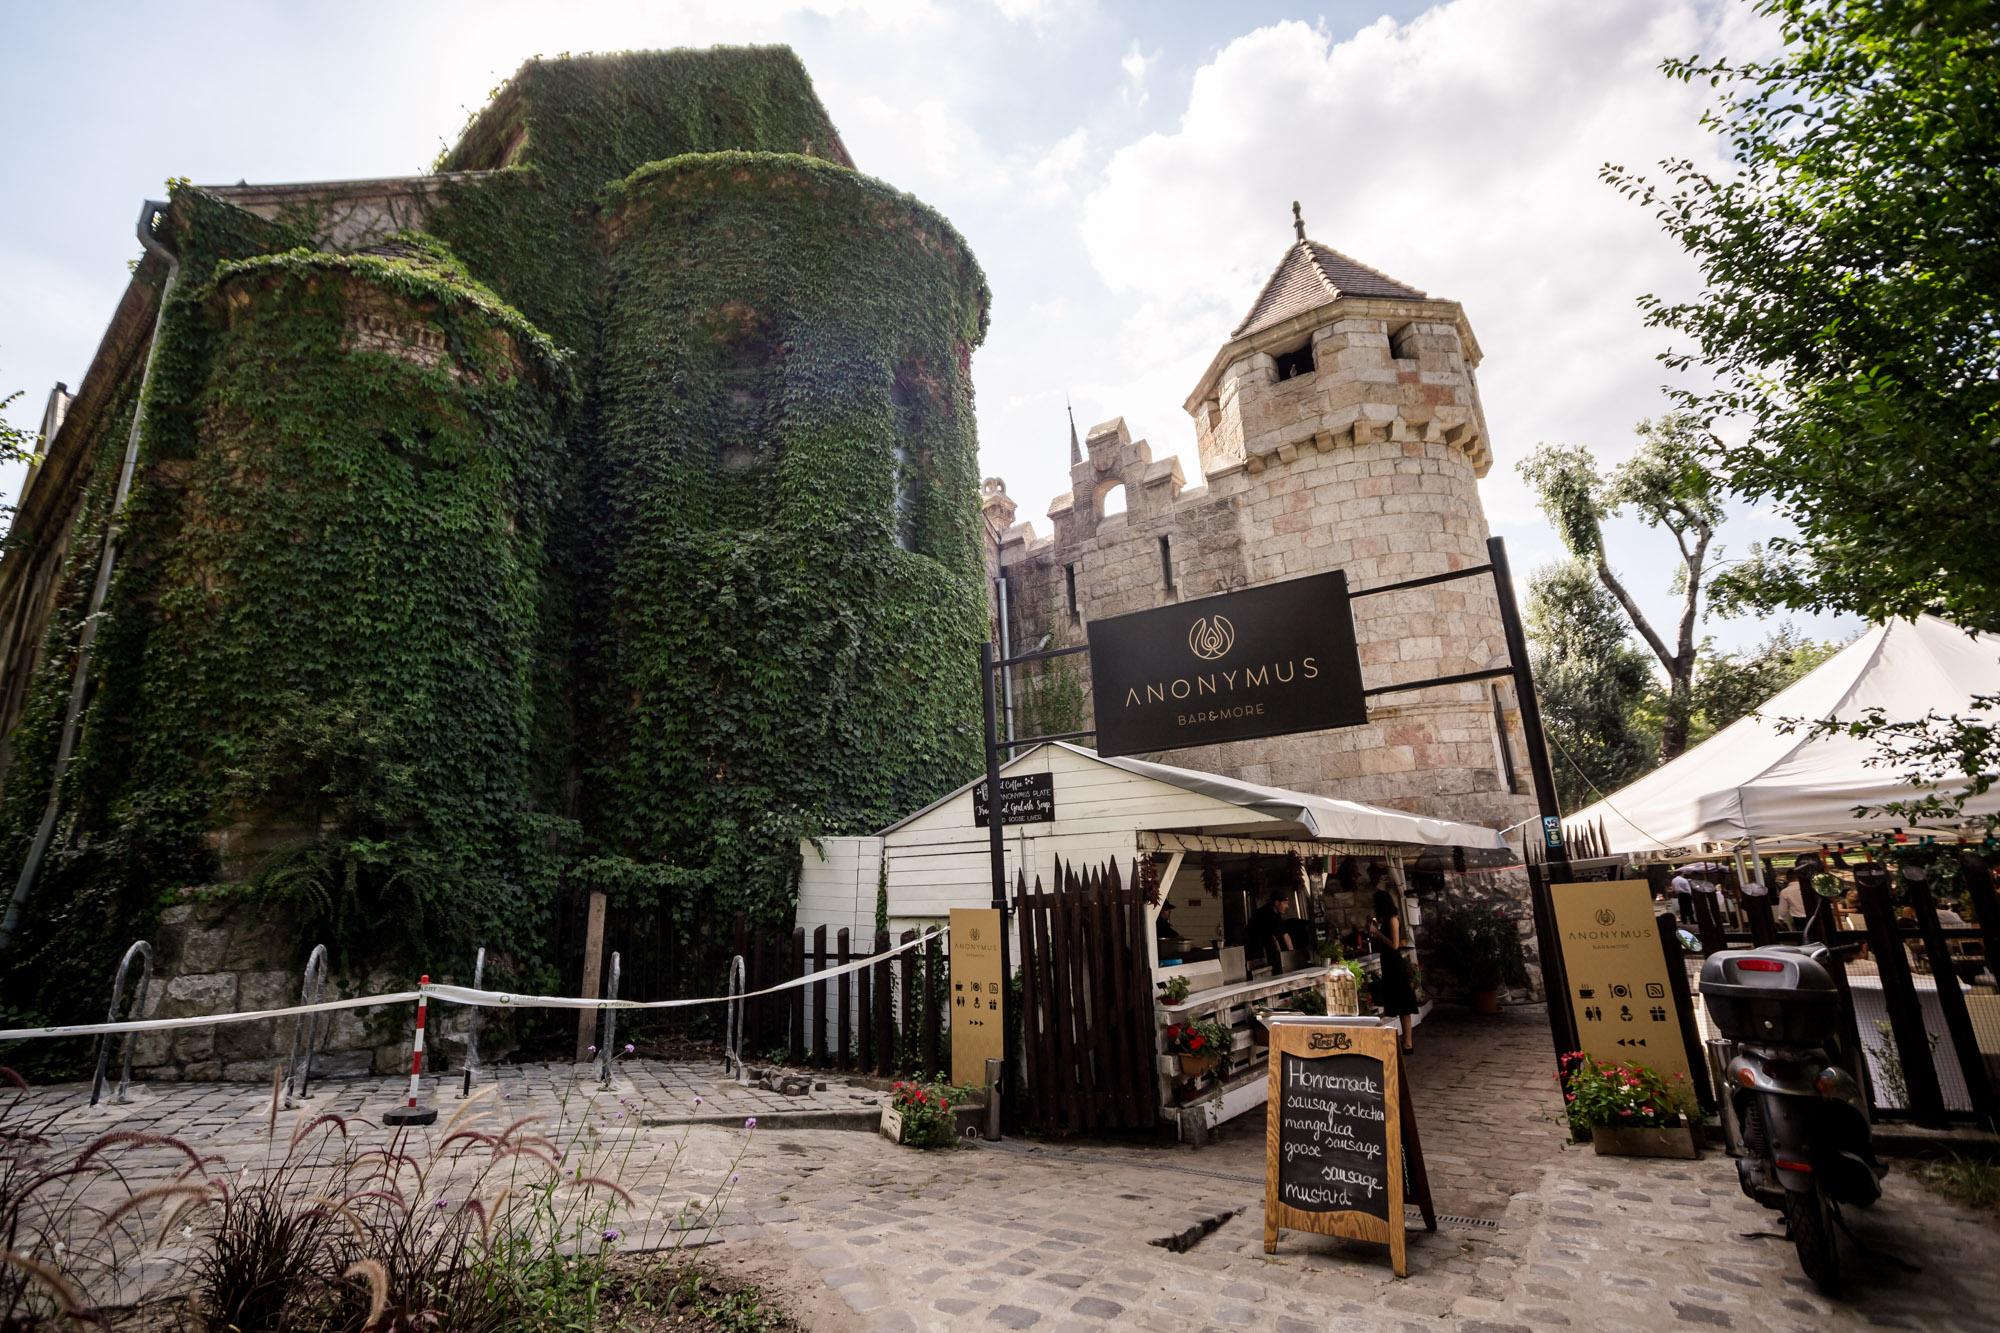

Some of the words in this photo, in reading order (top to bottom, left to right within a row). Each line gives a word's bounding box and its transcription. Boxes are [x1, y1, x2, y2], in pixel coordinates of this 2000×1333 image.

[1125, 657, 1319, 708] ANONYMUS
[1177, 703, 1265, 726] BAR&MORE
[954, 943, 997, 951] ANONYMUS
[1569, 929, 1652, 941] ANONYMUS
[1289, 1060, 1384, 1095] Homemade
[1288, 1095, 1341, 1119] sausage
[1285, 1117, 1354, 1141] mangalica
[1285, 1141, 1322, 1162] goose
[1325, 1136, 1382, 1160] sausage
[1285, 1182, 1352, 1206] mustard
[1321, 1166, 1383, 1199] sausage
